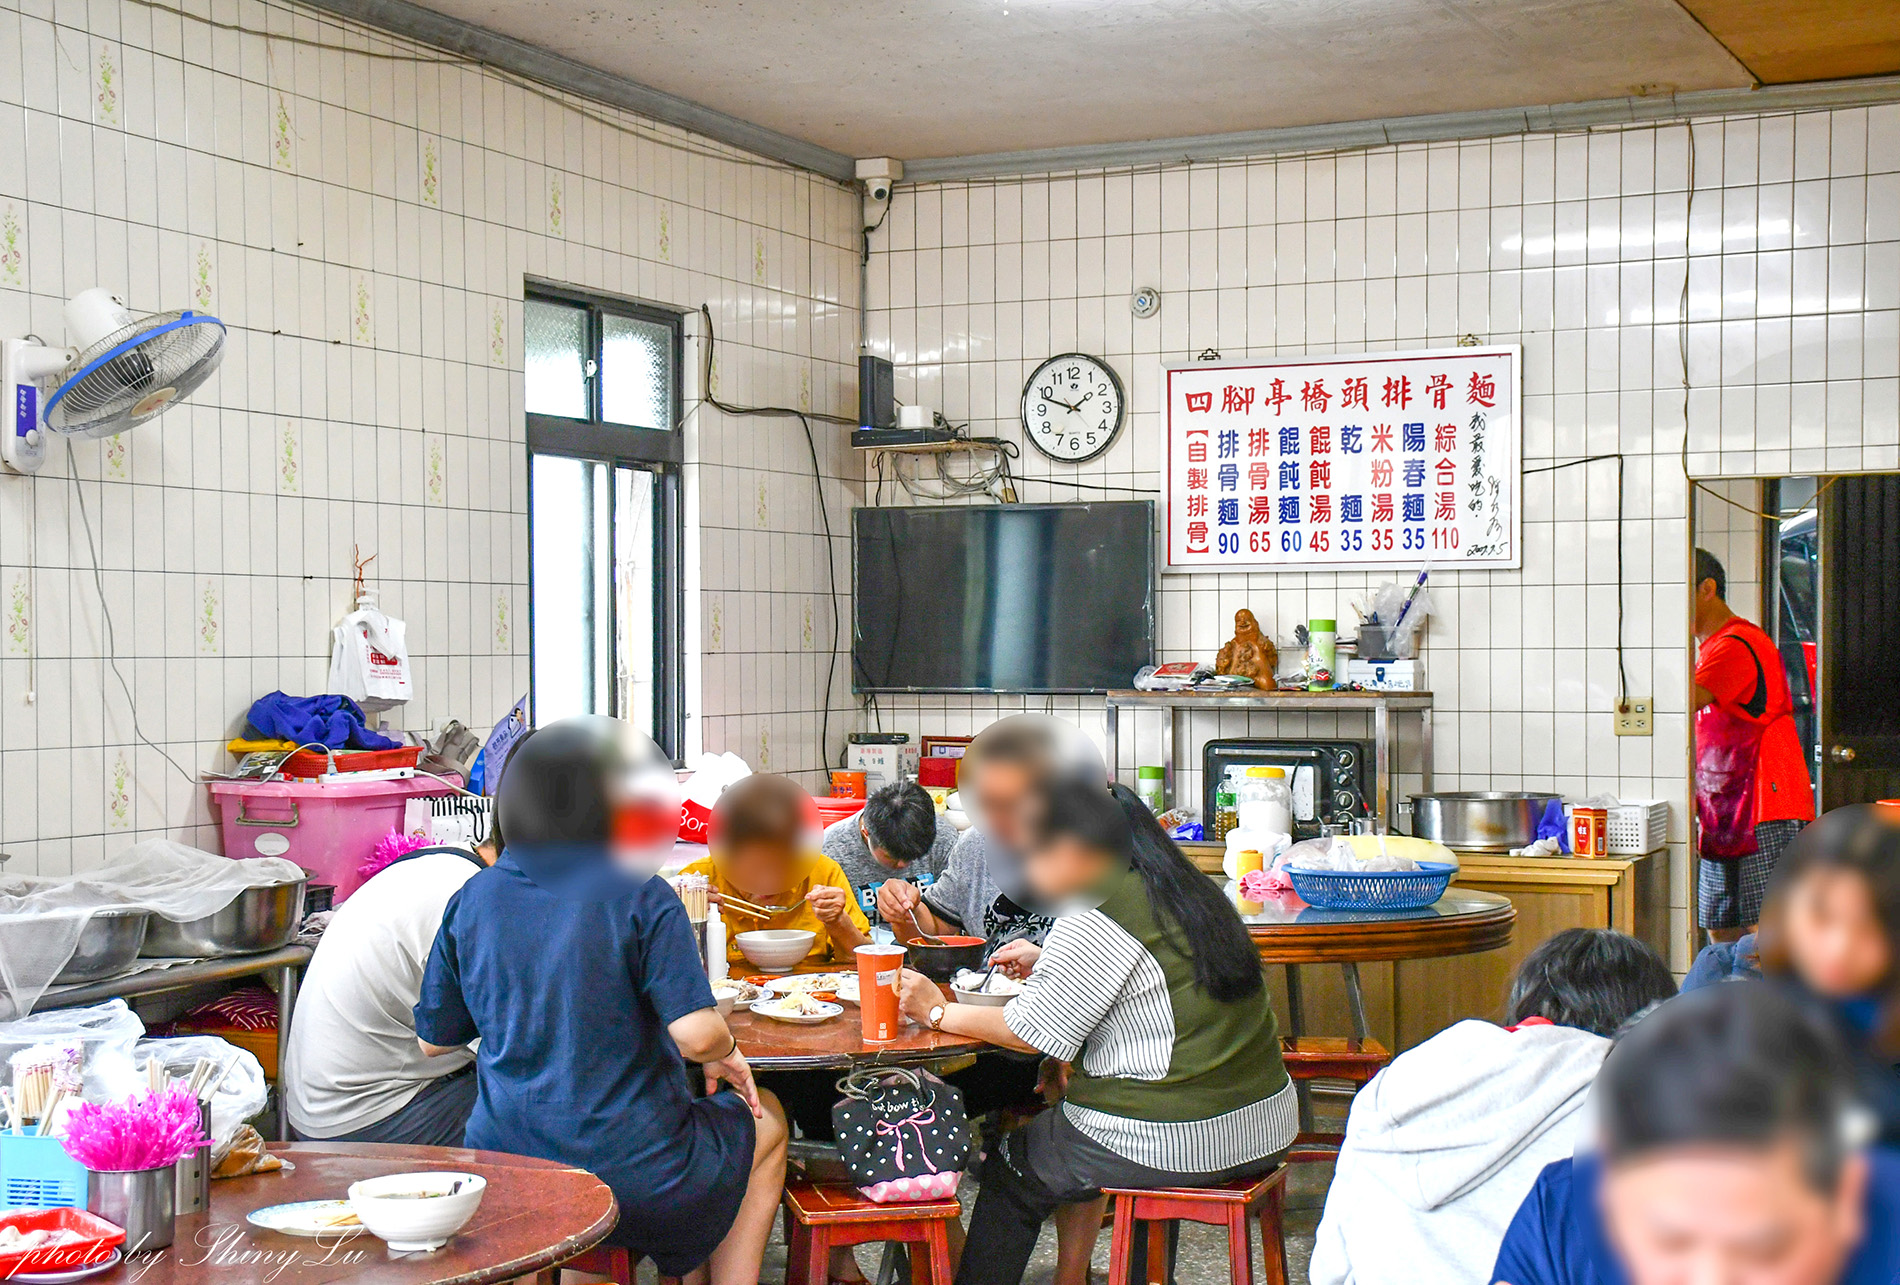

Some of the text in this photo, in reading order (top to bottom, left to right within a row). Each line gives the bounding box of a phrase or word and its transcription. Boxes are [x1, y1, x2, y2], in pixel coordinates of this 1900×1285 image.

[1052, 373, 1063, 386] 11
[1066, 366, 1080, 380] 12
[1087, 371, 1093, 383] 1
[1039, 386, 1053, 398] 10
[1097, 383, 1107, 396] 2
[1185, 371, 1496, 416] 四腳亭橋頭排骨麵
[1036, 403, 1047, 418] 9
[1102, 400, 1113, 414] 3
[1041, 421, 1051, 434] 8
[1098, 419, 1108, 432] 4
[1055, 433, 1064, 446] 7
[1069, 437, 1080, 451] 6
[1086, 432, 1096, 445] 5
[1217, 429, 1239, 554] 排骨麵 90
[1247, 427, 1270, 552] 排骨湯 65
[1278, 426, 1302, 552] 餛飩麵 60
[1309, 425, 1331, 552] 餛飩湯 45
[1371, 423, 1394, 550] 米粉湯 35
[1402, 422, 1425, 550] 陽春麵 35
[1431, 423, 1459, 549] 綜合湯 110
[1340, 529, 1362, 551] 35
[887, 1101, 909, 1112] bow
